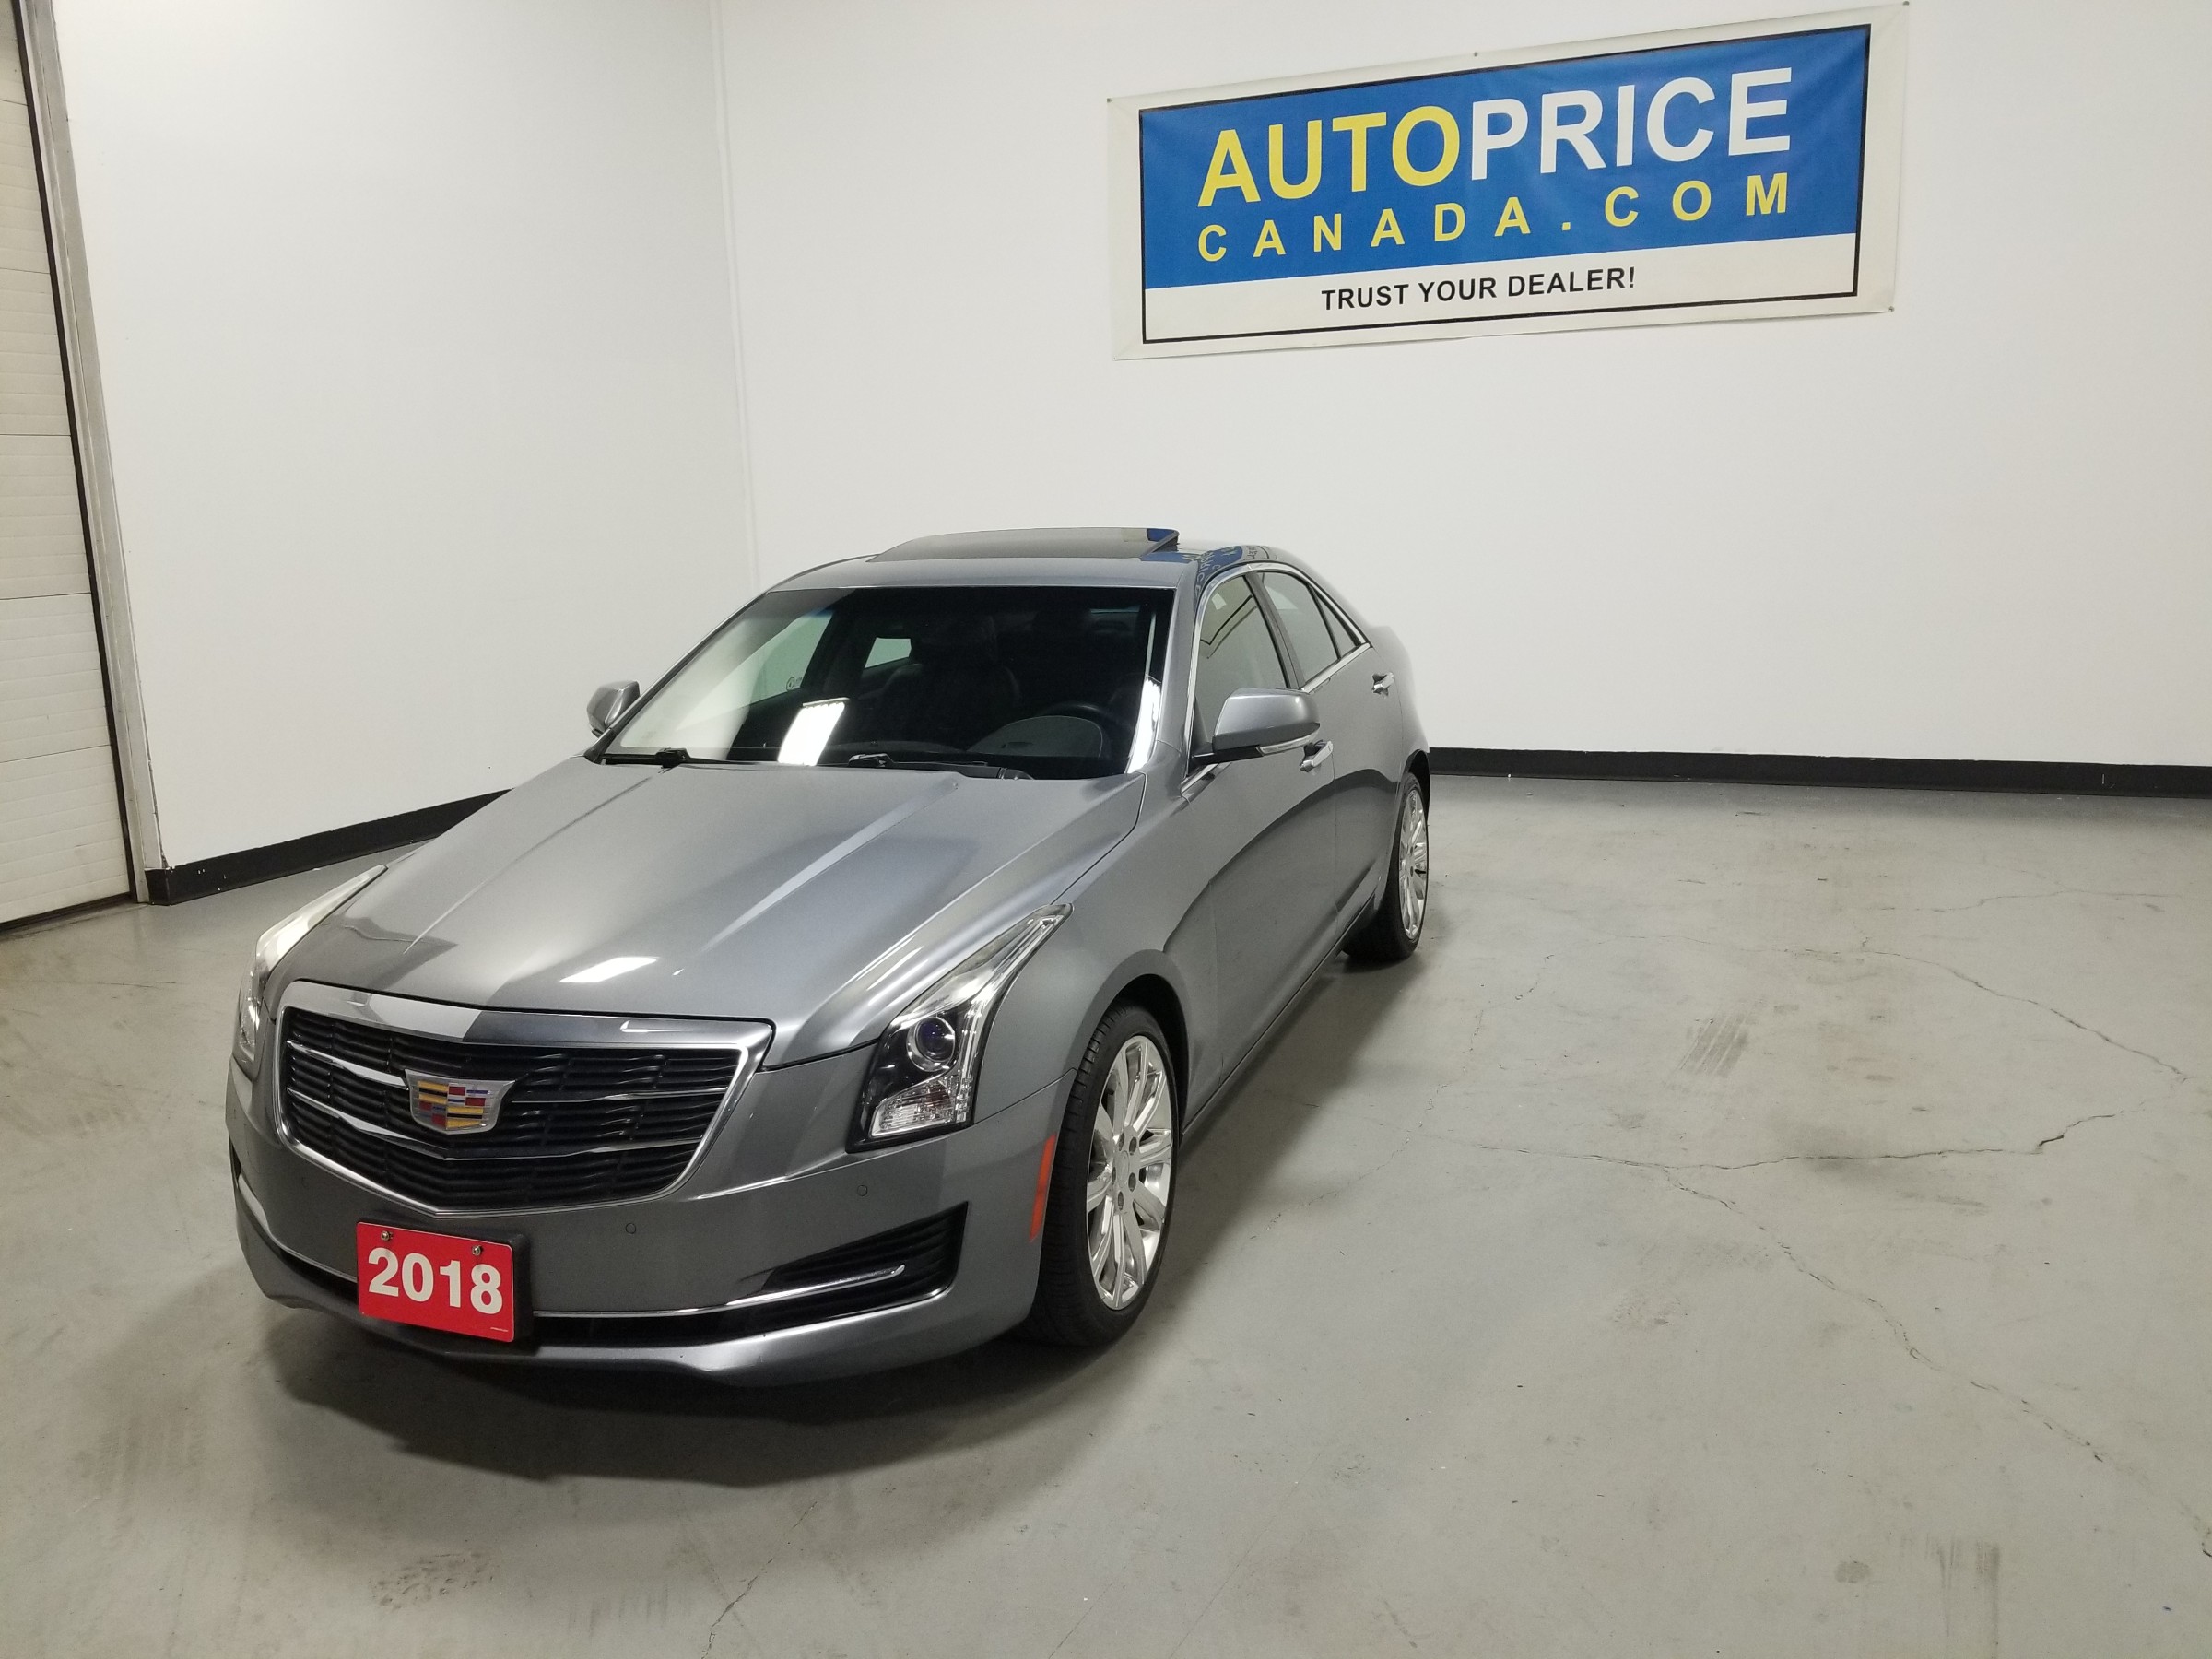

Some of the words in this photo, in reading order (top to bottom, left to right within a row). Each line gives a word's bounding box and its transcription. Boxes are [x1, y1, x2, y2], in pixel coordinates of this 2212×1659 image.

[1198, 67, 1792, 207] AUTOPRICE
[1198, 172, 1788, 262] CANADA.COM
[1321, 283, 1409, 311] TRUST
[1418, 277, 1497, 302] YOUR
[1508, 266, 1635, 297] DEALER!
[368, 1247, 503, 1314] 2018
